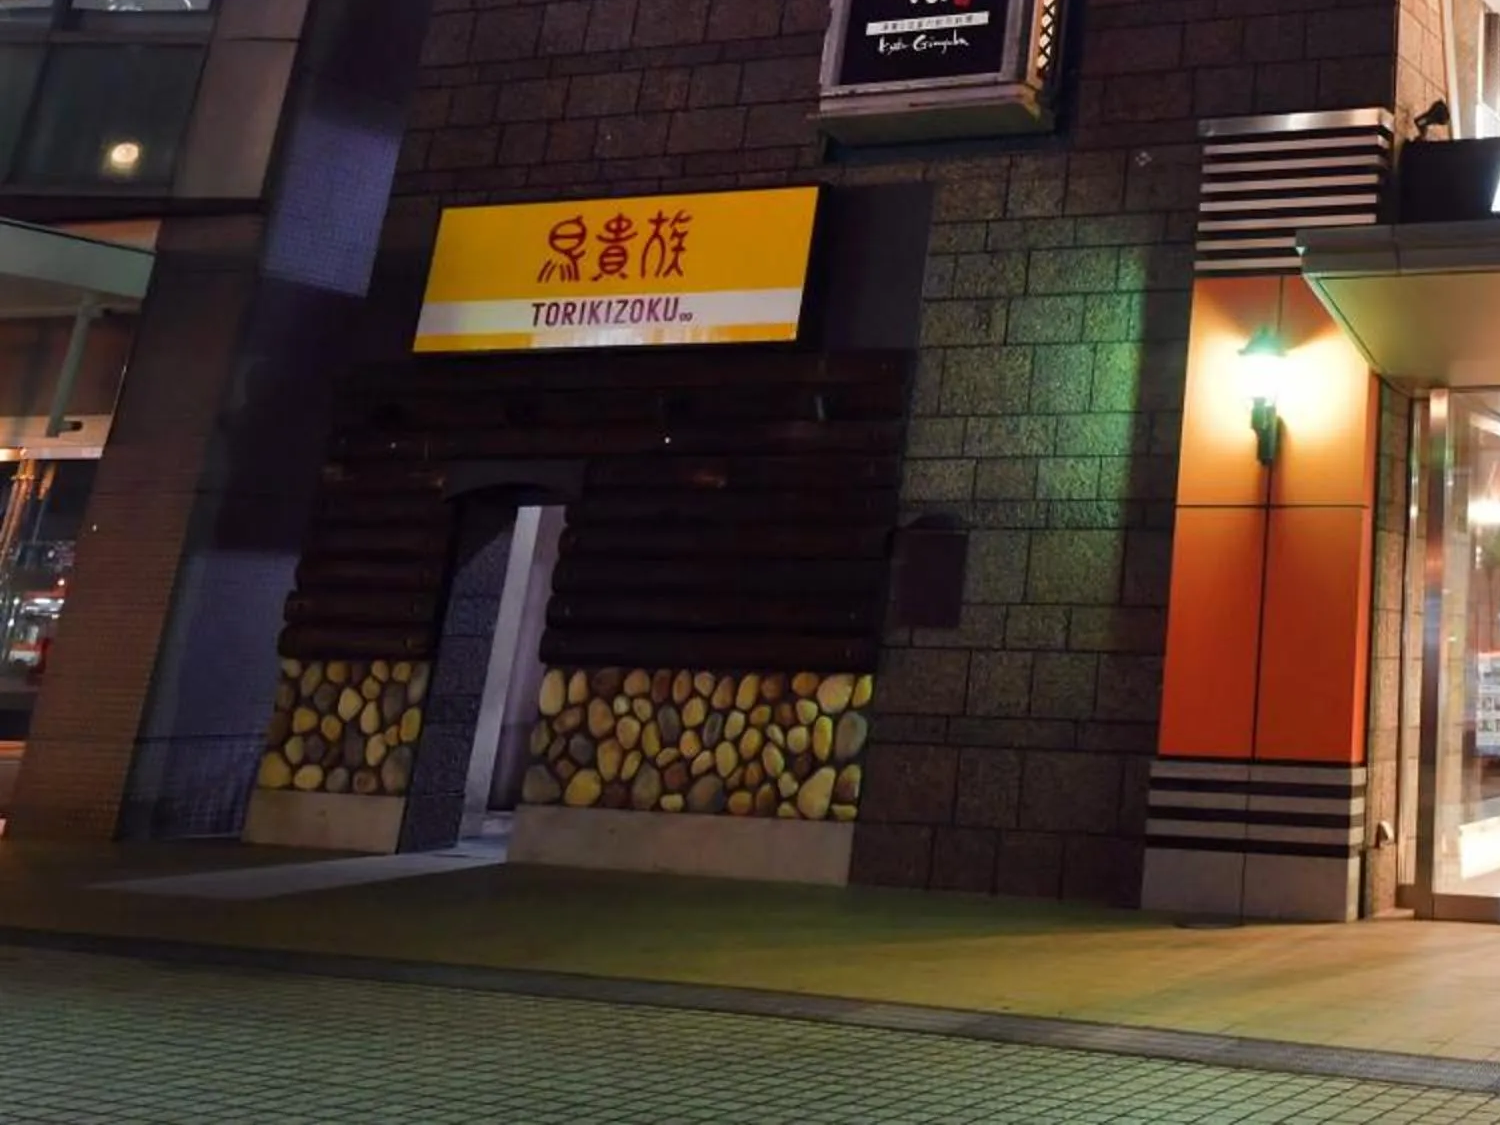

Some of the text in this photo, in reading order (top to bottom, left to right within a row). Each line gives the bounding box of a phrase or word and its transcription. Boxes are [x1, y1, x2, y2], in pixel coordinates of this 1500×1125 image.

[537, 210, 693, 283] 鳥貴族
[531, 297, 679, 327] TORIKIZOKU
